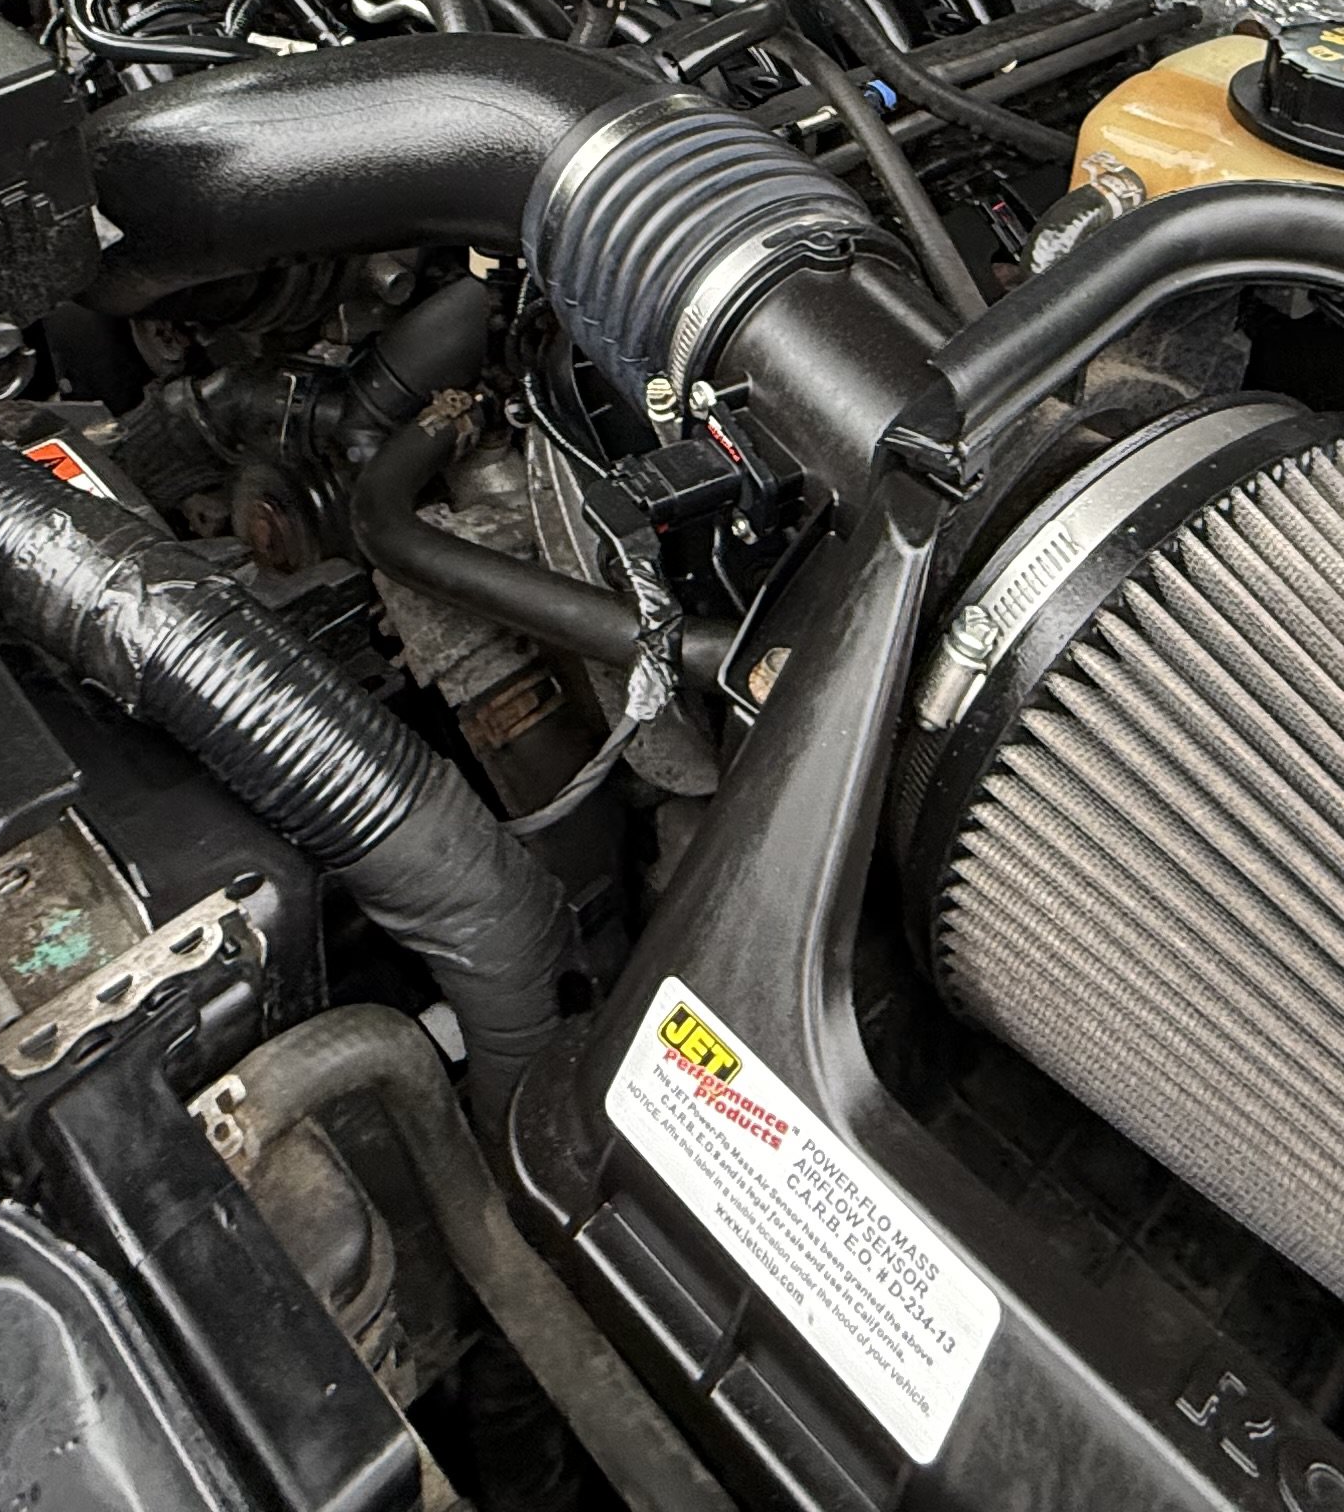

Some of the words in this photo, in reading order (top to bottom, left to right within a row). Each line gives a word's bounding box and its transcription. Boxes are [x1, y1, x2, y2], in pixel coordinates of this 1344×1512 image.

[665, 1016, 735, 1076] JET
[652, 1063, 672, 1088] This
[670, 1085, 690, 1105] JET
[687, 1101, 730, 1151] Power-Flo
[730, 1146, 755, 1177] Mass
[753, 1173, 770, 1191] Air
[768, 1187, 803, 1225] Sensor
[801, 1222, 821, 1246] has
[819, 1242, 845, 1273] been
[843, 1270, 886, 1314] granted
[883, 1310, 901, 1332] the
[901, 1330, 934, 1367] above
[660, 1094, 695, 1136] C.A.R.B.
[719, 1159, 739, 1180] and
[736, 1176, 746, 1190] is
[745, 1185, 771, 1214] legal
[766, 1210, 786, 1230] for
[784, 1228, 805, 1252] sale
[804, 1250, 826, 1273] and
[823, 1270, 843, 1293] use
[841, 1289, 854, 1305] in
[853, 1301, 905, 1363] California.
[660, 1119, 680, 1141] Affix
[678, 1138, 694, 1158] this
[693, 1154, 716, 1180] label
[713, 1176, 723, 1189] in
[722, 1186, 730, 1197] a
[729, 1194, 756, 1225] visible
[756, 1222, 791, 1263] location
[790, 1260, 818, 1290] under
[816, 1287, 833, 1308] the
[831, 1304, 859, 1335] hood
[856, 1333, 871, 1346] of
[865, 1344, 891, 1370] your
[890, 1367, 930, 1417] vehicle.
[715, 1202, 805, 1306] www.jetchip.com
[786, 1173, 841, 1239] C.A.R.B.
[843, 1232, 873, 1273] E.O.
[875, 1267, 889, 1283] #
[887, 1279, 956, 1354] D-234-13
[792, 1158, 865, 1228] AIRFLOW
[861, 1225, 929, 1300] SENSOR
[801, 1138, 892, 1232] POWER-FLO
[890, 1229, 940, 1283] MASS
